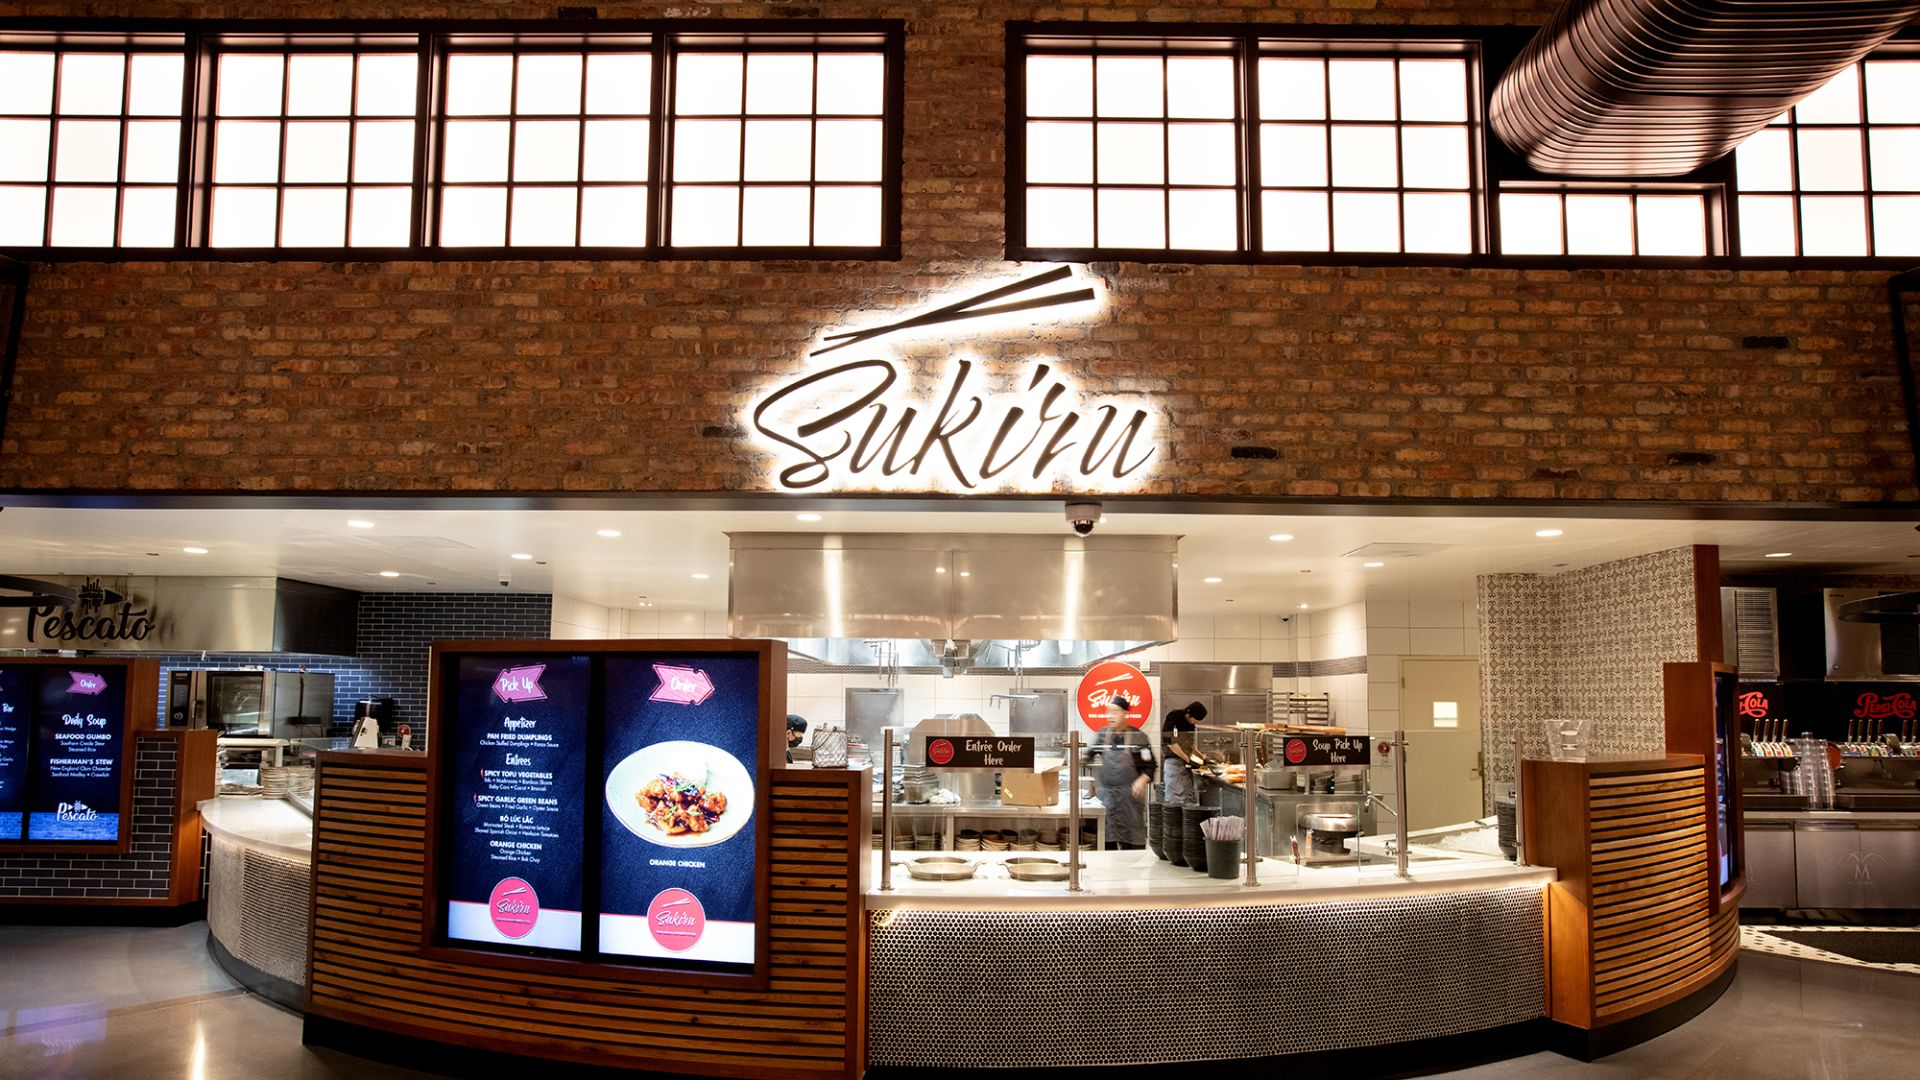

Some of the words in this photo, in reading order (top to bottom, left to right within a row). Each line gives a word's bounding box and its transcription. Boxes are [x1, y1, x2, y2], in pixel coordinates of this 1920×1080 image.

[27, 602, 156, 643] Pescato
[500, 677, 519, 692] Pick
[522, 677, 534, 692] Up
[670, 678, 698, 693] Order
[86, 714, 107, 728] Soup
[504, 716, 537, 731] Appetizer
[55, 732, 85, 740] SEAFOOD
[487, 732, 500, 740] PAN
[966, 740, 993, 753] Entrée
[997, 740, 1023, 753] Order
[1312, 738, 1331, 753] Soup
[1334, 738, 1351, 751] Pick
[1353, 739, 1363, 752] Up
[984, 754, 1004, 766] Here
[1330, 752, 1347, 764] Here
[57, 802, 98, 822] Pescato
[490, 840, 516, 848] ORANGE
[516, 842, 542, 850] CHICKEN
[650, 859, 676, 867] ORANGE
[678, 860, 705, 868] CHICKEN
